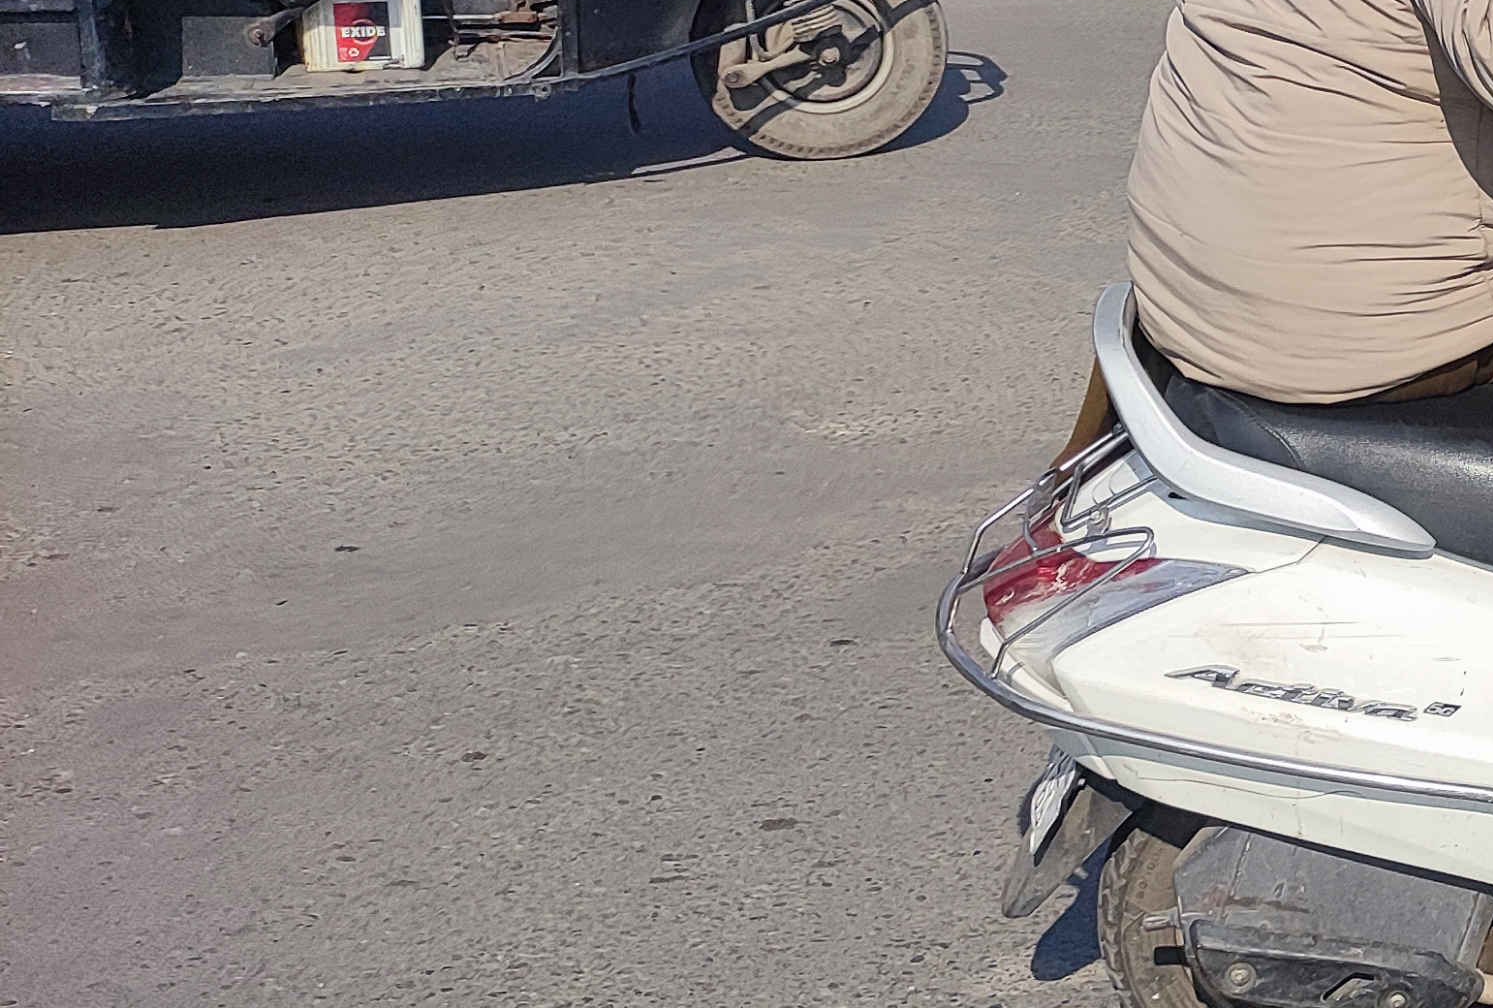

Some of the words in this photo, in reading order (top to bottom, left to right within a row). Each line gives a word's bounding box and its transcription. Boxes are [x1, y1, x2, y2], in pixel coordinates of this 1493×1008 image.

[341, 25, 387, 38] EXIDE
[1164, 664, 1419, 721] Activa
[1424, 701, 1462, 717] 5G
